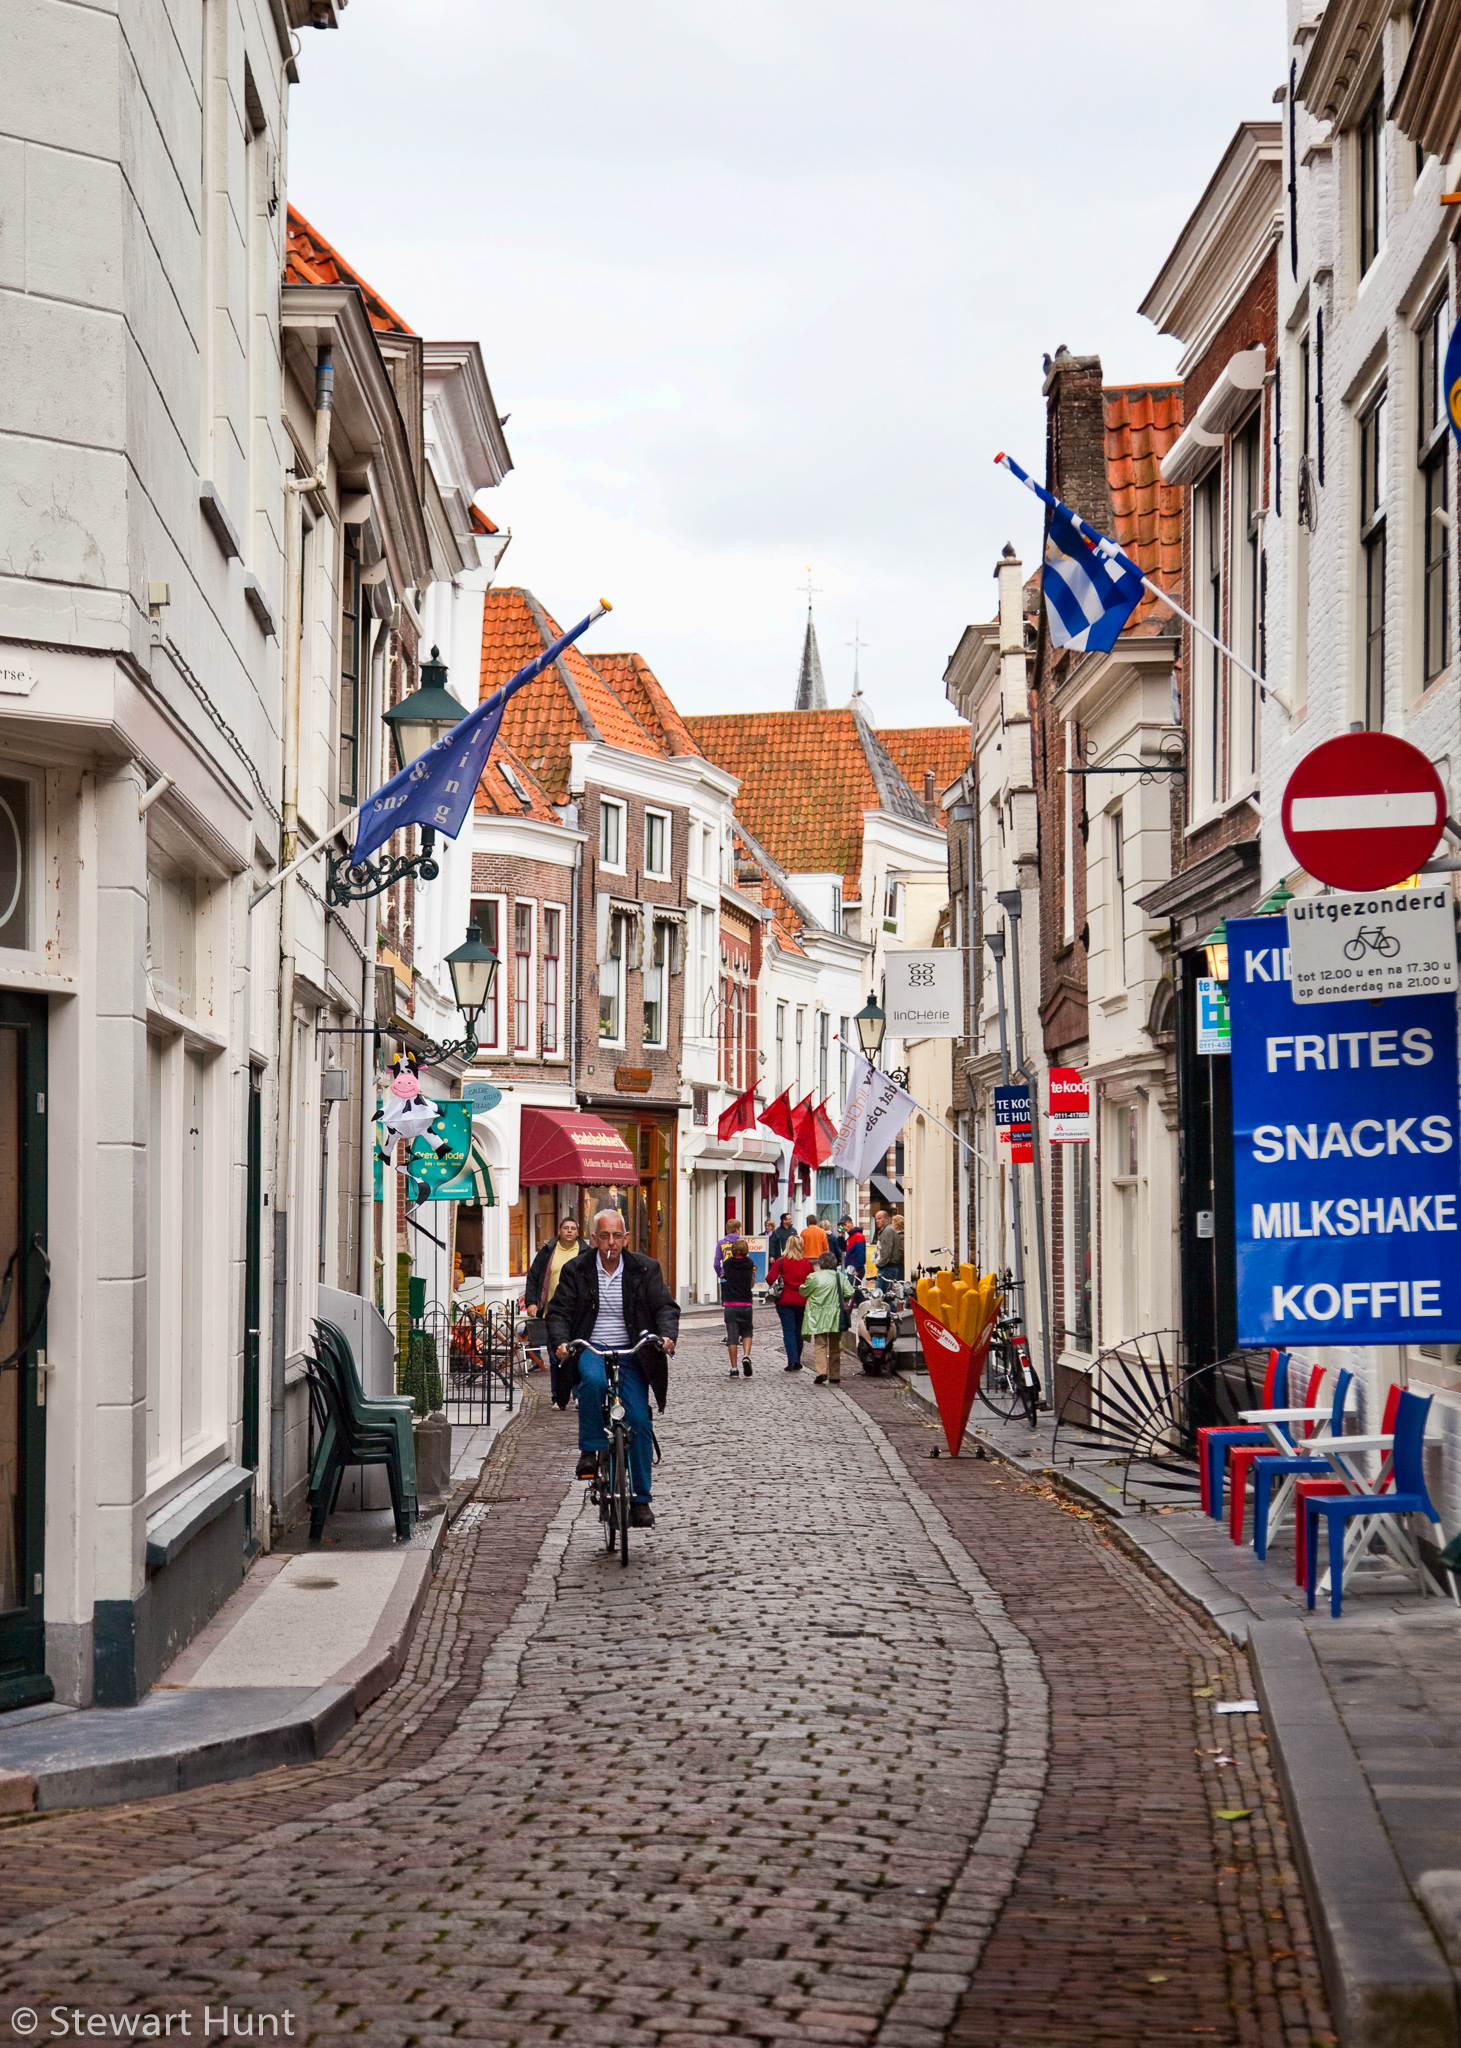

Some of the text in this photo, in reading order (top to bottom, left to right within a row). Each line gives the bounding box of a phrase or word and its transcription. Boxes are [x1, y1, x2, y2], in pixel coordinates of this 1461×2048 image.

[1293, 891, 1446, 923] uitgezonderd
[1297, 961, 1451, 982] tot 12.00 u en na 17.30 u
[1299, 976, 1452, 997] op donderdag na 21.00 u
[1266, 1027, 1434, 1073] FRITES
[996, 1098, 1031, 1110] TE KOO
[997, 1111, 1031, 1123] TE HUU
[1252, 1115, 1453, 1163] SNACKS
[1252, 1194, 1458, 1240] MILKSHAKE
[1272, 1279, 1442, 1321] KOFFIE
[926, 1321, 942, 1337] FARM
